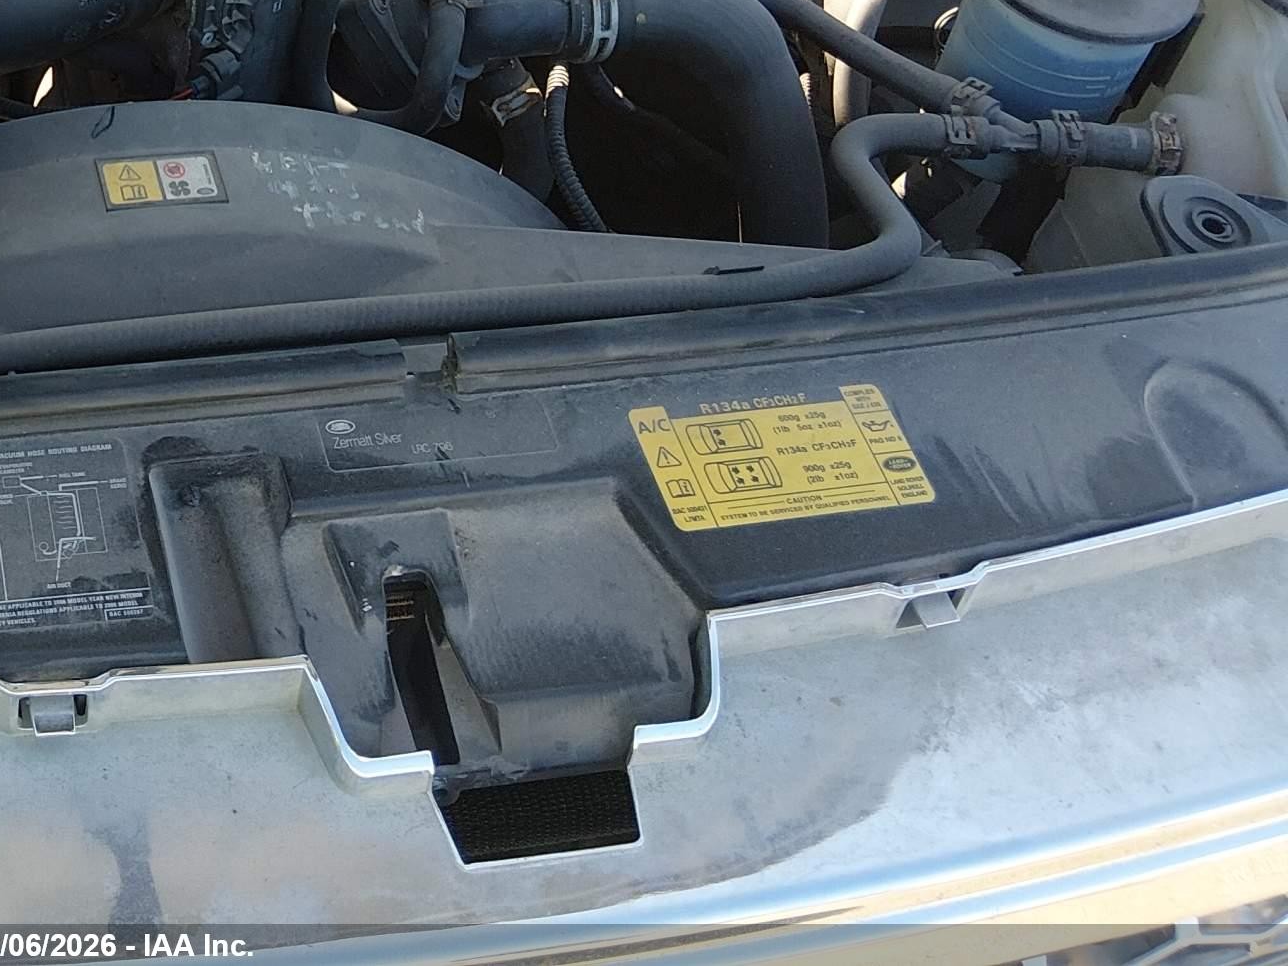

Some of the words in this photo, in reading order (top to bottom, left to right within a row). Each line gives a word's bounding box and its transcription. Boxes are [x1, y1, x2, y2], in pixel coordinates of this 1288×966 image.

[699, 400, 751, 415] R134a
[638, 418, 671, 434] A/C
[773, 425, 790, 435] (1lb
[333, 434, 373, 449] Zermatt
[374, 432, 402, 445] Silver
[776, 446, 808, 456] R134a
[807, 475, 824, 485] (2lb
[786, 495, 822, 504] CAUTION
[721, 512, 748, 520] SYSTEM
[771, 506, 803, 515] SERVICED
[815, 500, 850, 510] QUALIFIED
[852, 495, 890, 505] PERSONNEL
